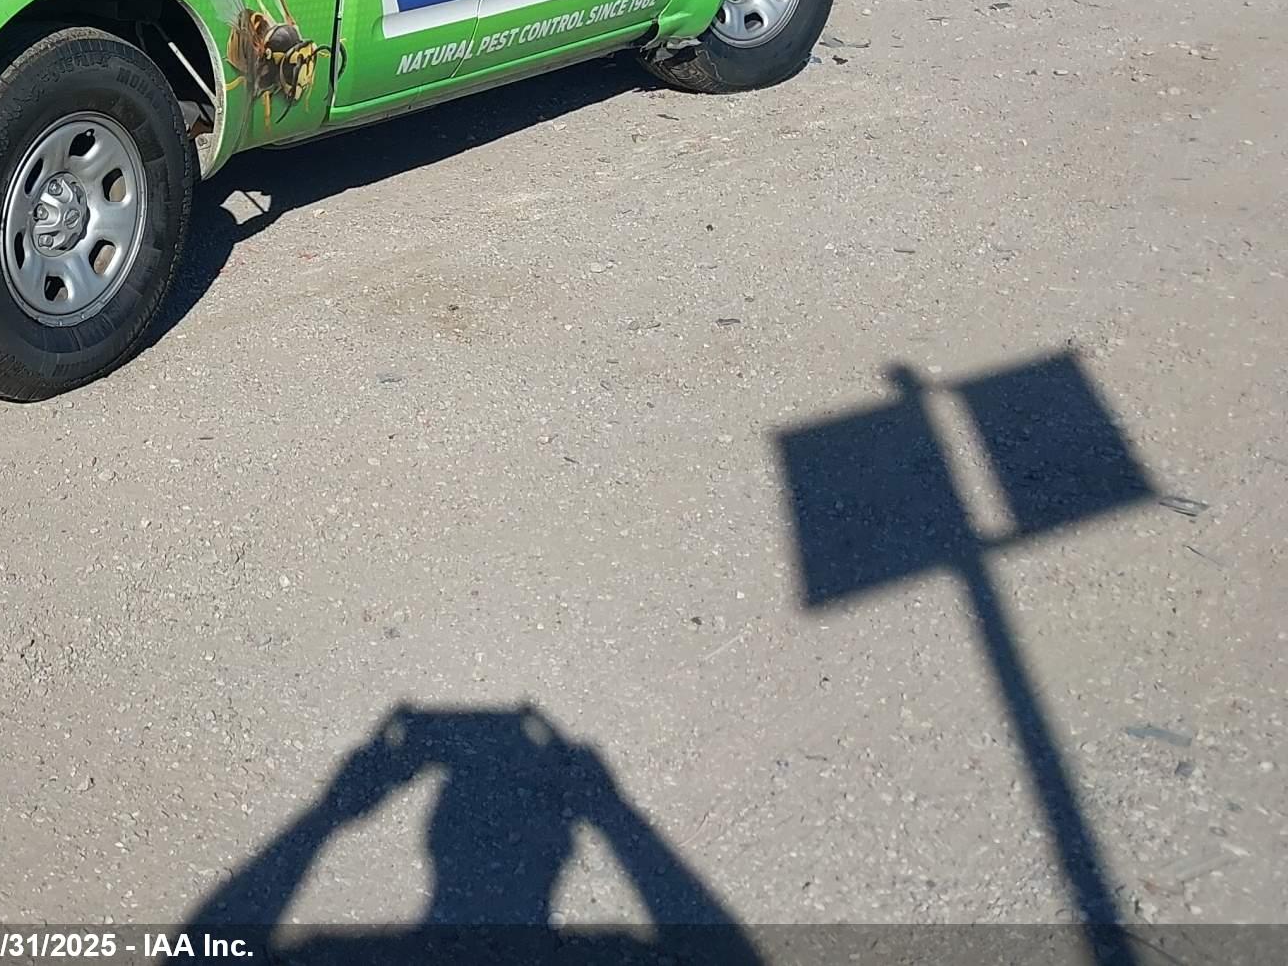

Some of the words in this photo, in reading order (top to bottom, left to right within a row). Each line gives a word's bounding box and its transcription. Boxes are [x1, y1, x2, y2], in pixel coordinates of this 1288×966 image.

[396, 39, 475, 76] NATURAL
[476, 27, 520, 57] PEST
[518, 10, 585, 44] CONTROL
